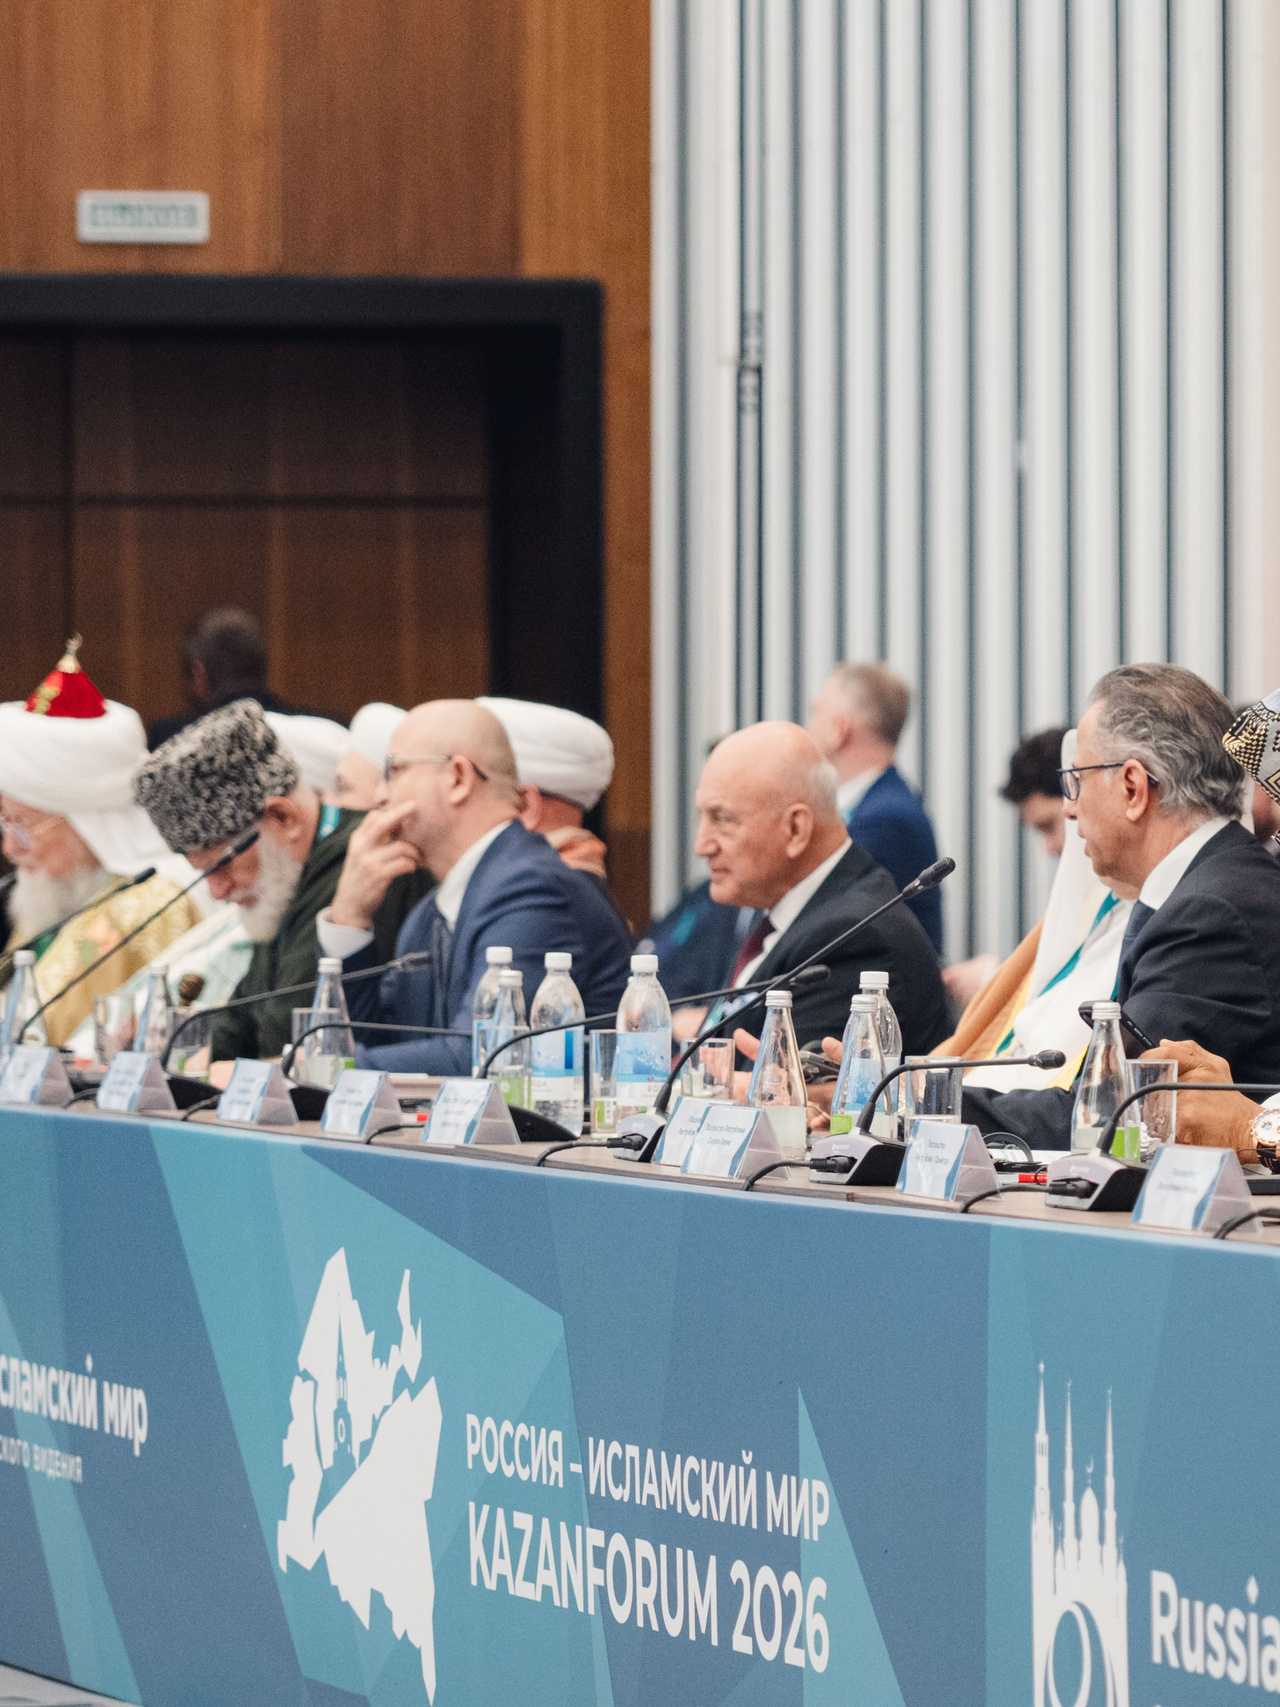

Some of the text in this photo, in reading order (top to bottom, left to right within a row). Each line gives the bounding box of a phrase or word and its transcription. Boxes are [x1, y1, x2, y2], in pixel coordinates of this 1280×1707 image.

[103, 1380, 148, 1457] мир
[466, 1413, 564, 1488] РОССИЯ
[588, 1437, 758, 1519] ИСЛАМСКИЙ
[766, 1471, 830, 1542] МИР
[468, 1501, 830, 1674] KAZANFORUM 2026
